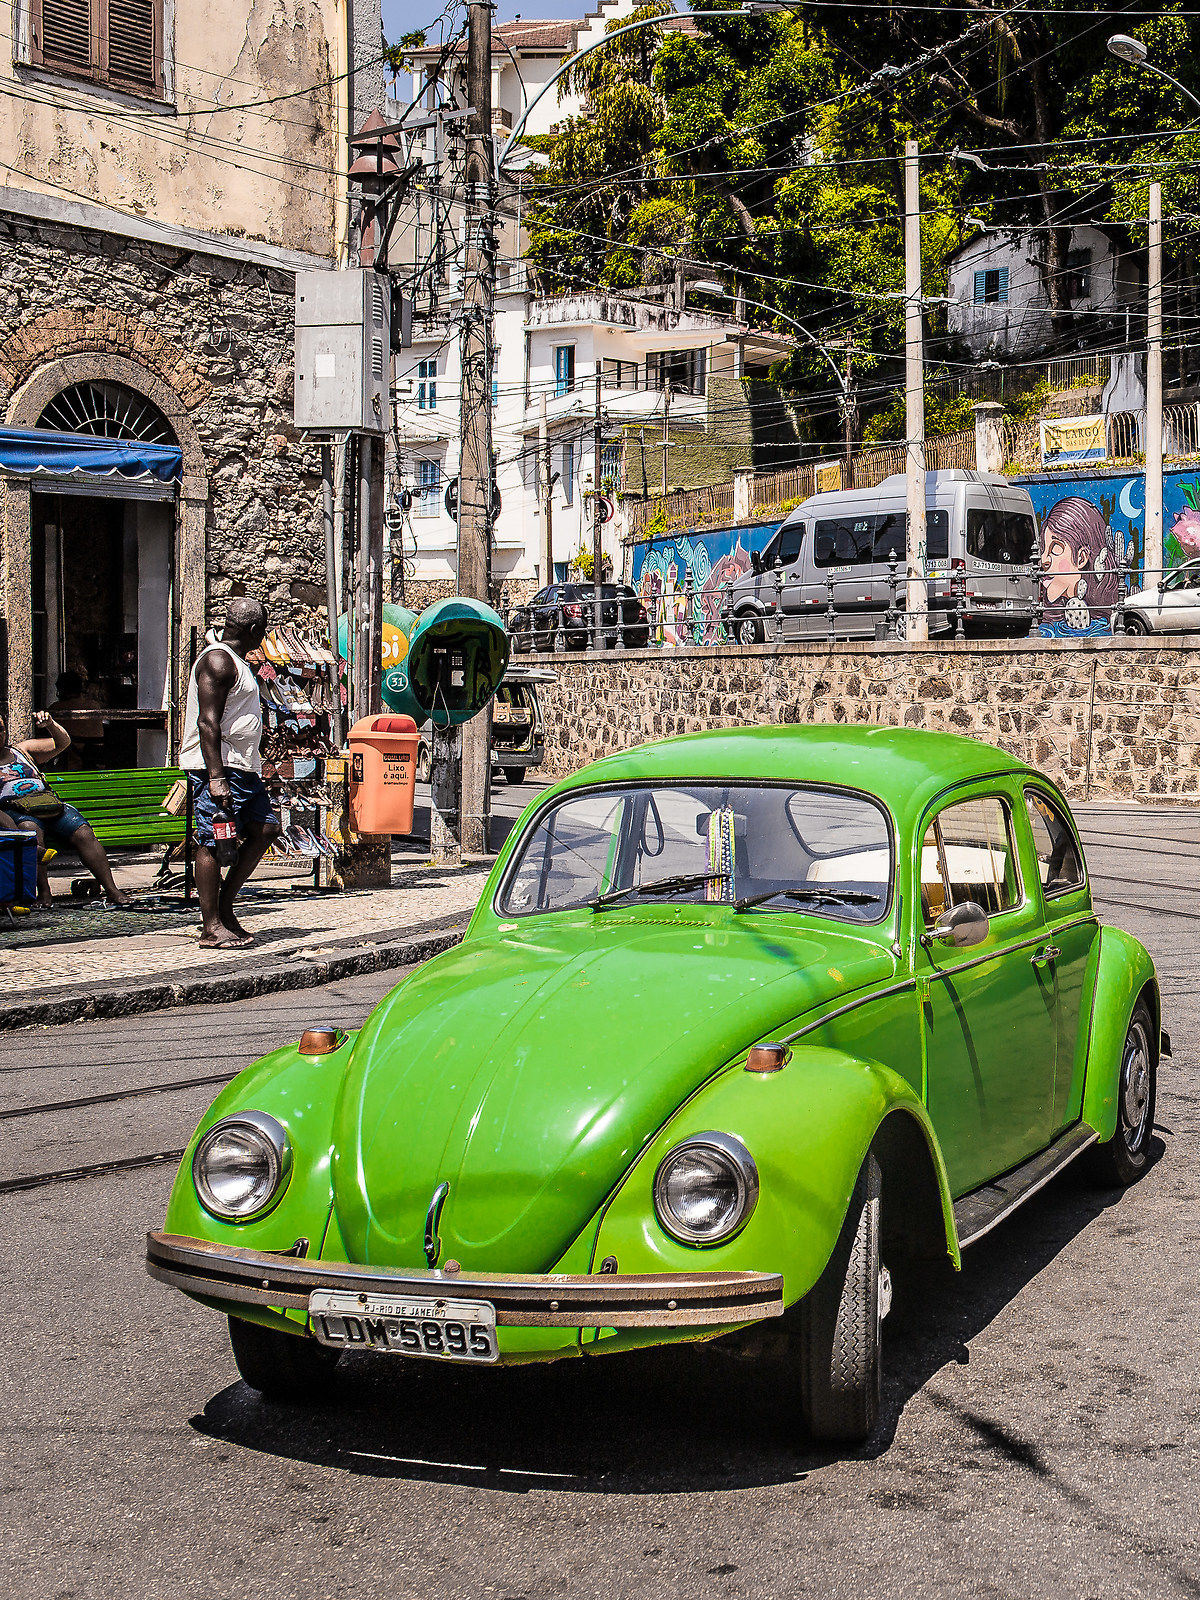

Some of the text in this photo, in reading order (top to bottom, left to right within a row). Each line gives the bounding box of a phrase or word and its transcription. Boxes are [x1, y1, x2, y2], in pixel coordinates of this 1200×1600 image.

[1065, 426, 1098, 439] LARGO
[391, 676, 404, 687] 31
[390, 771, 409, 780] aqui.
[363, 1303, 446, 1318] RJ-RIO DE JANEIRO
